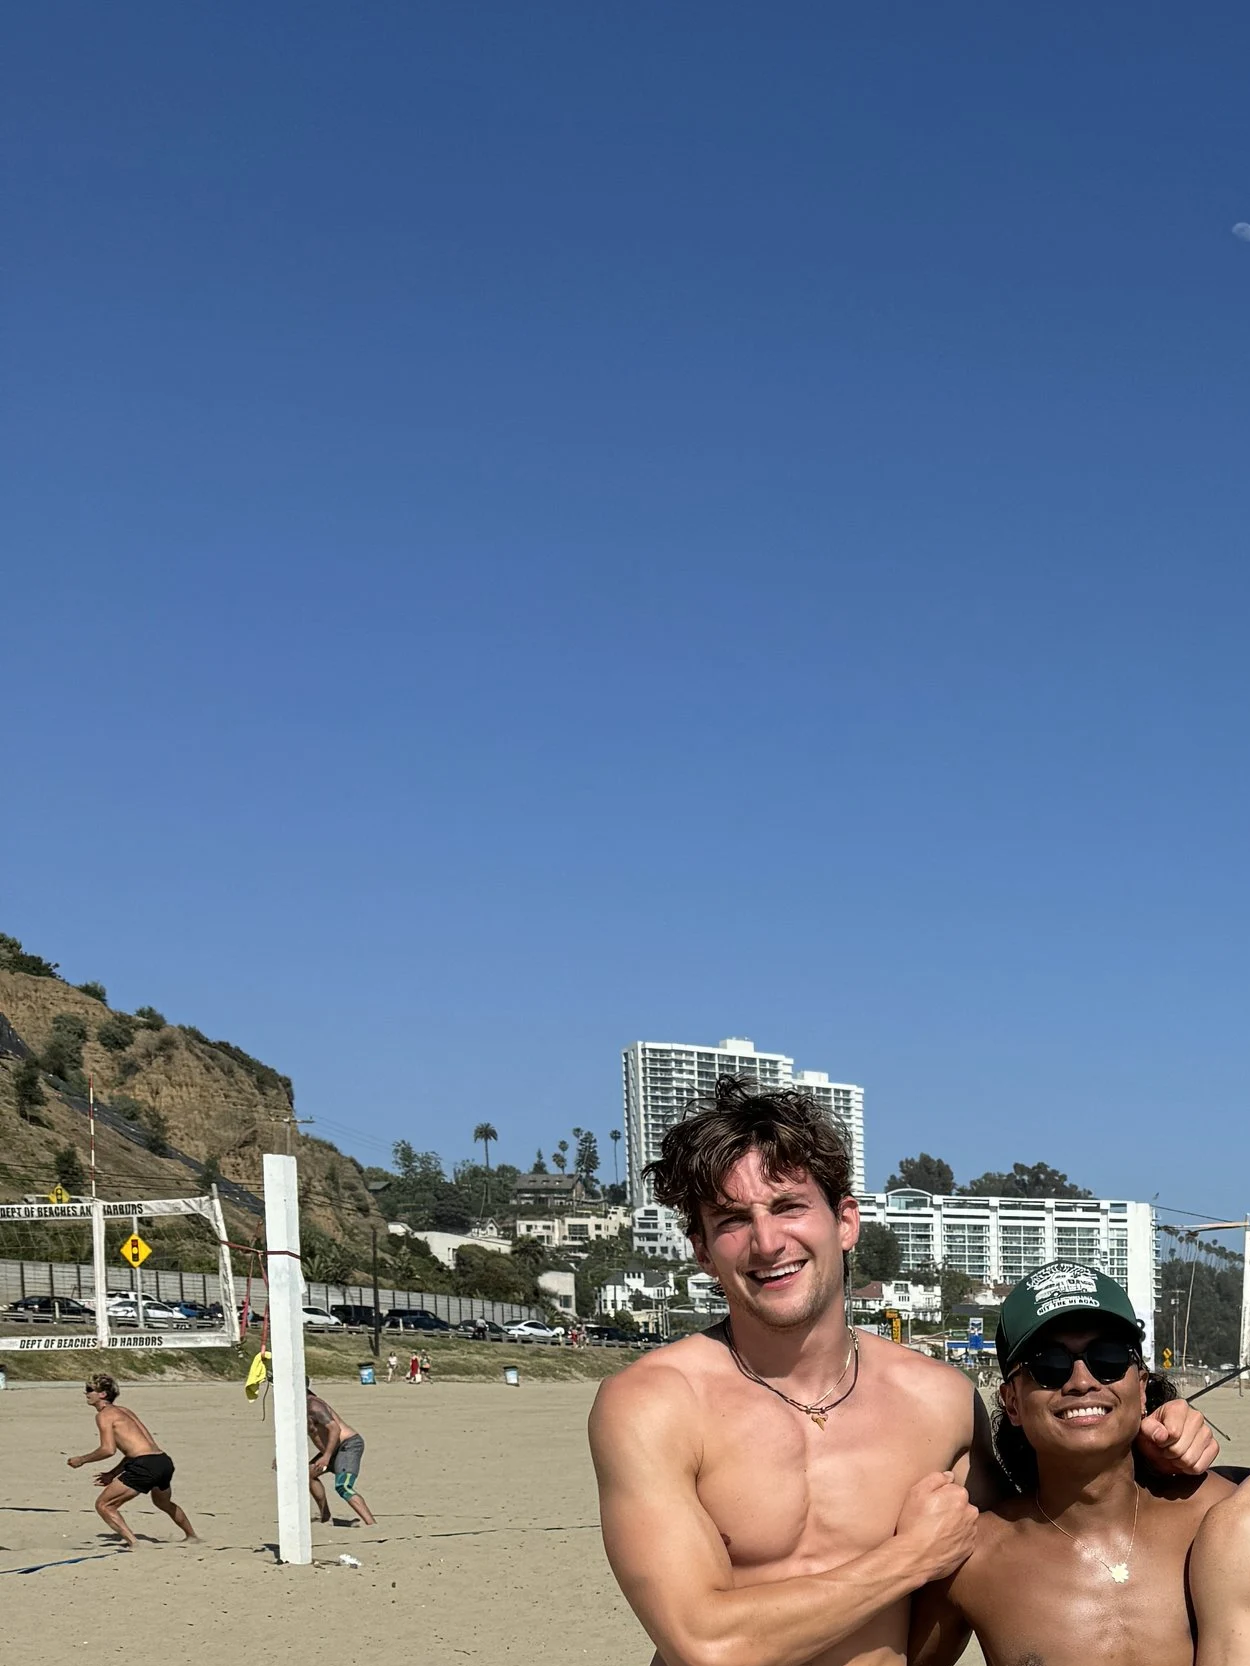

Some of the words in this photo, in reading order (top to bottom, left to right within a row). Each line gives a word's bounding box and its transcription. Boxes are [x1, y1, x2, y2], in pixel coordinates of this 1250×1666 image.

[24, 1207, 35, 1218] OF
[37, 1206, 77, 1217] BEACHES
[20, 1339, 41, 1349] DEPT
[44, 1338, 55, 1349] OF
[57, 1338, 98, 1348] BEACHES
[119, 1336, 164, 1347] HARBORS
